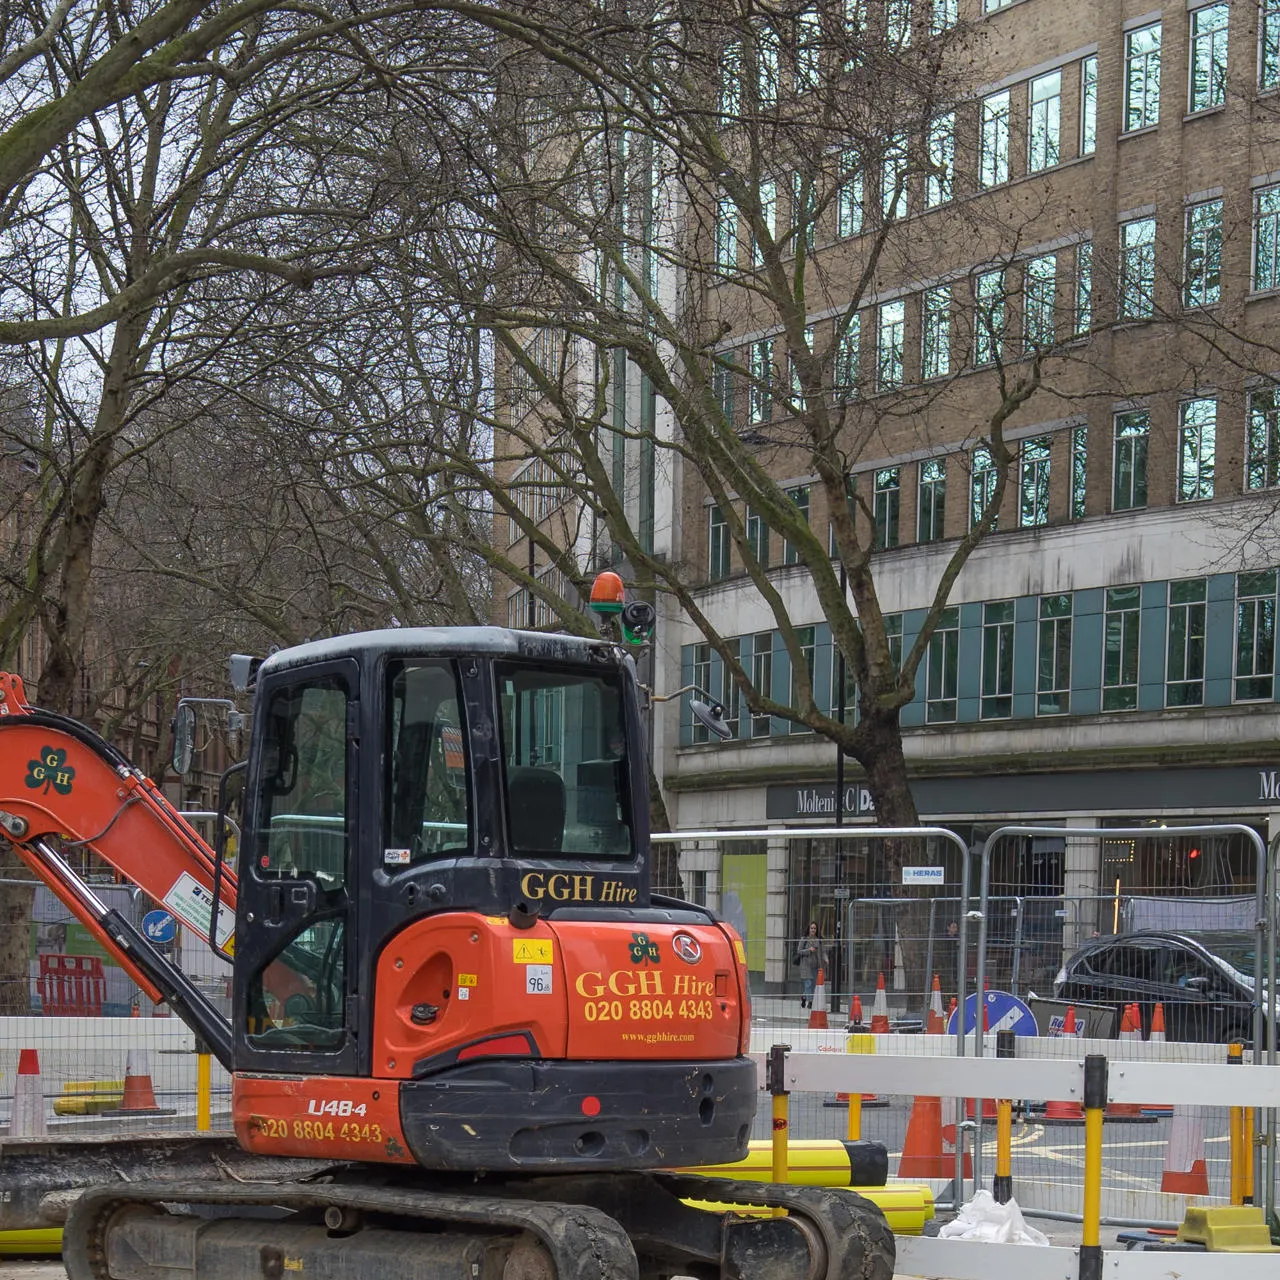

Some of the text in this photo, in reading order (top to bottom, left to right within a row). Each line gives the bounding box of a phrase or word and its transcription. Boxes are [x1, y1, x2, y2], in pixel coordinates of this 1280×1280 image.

[46, 755, 57, 768] G
[33, 767, 69, 786] G H
[521, 873, 637, 903] GGH Hire
[529, 978, 543, 992] 96
[575, 970, 714, 998] GGH Hire
[584, 1000, 713, 1021] 020 8804 4343
[622, 1032, 695, 1044] www.gghhire.com
[293, 1121, 335, 1140] 8804
[340, 1123, 382, 1142] 4343
